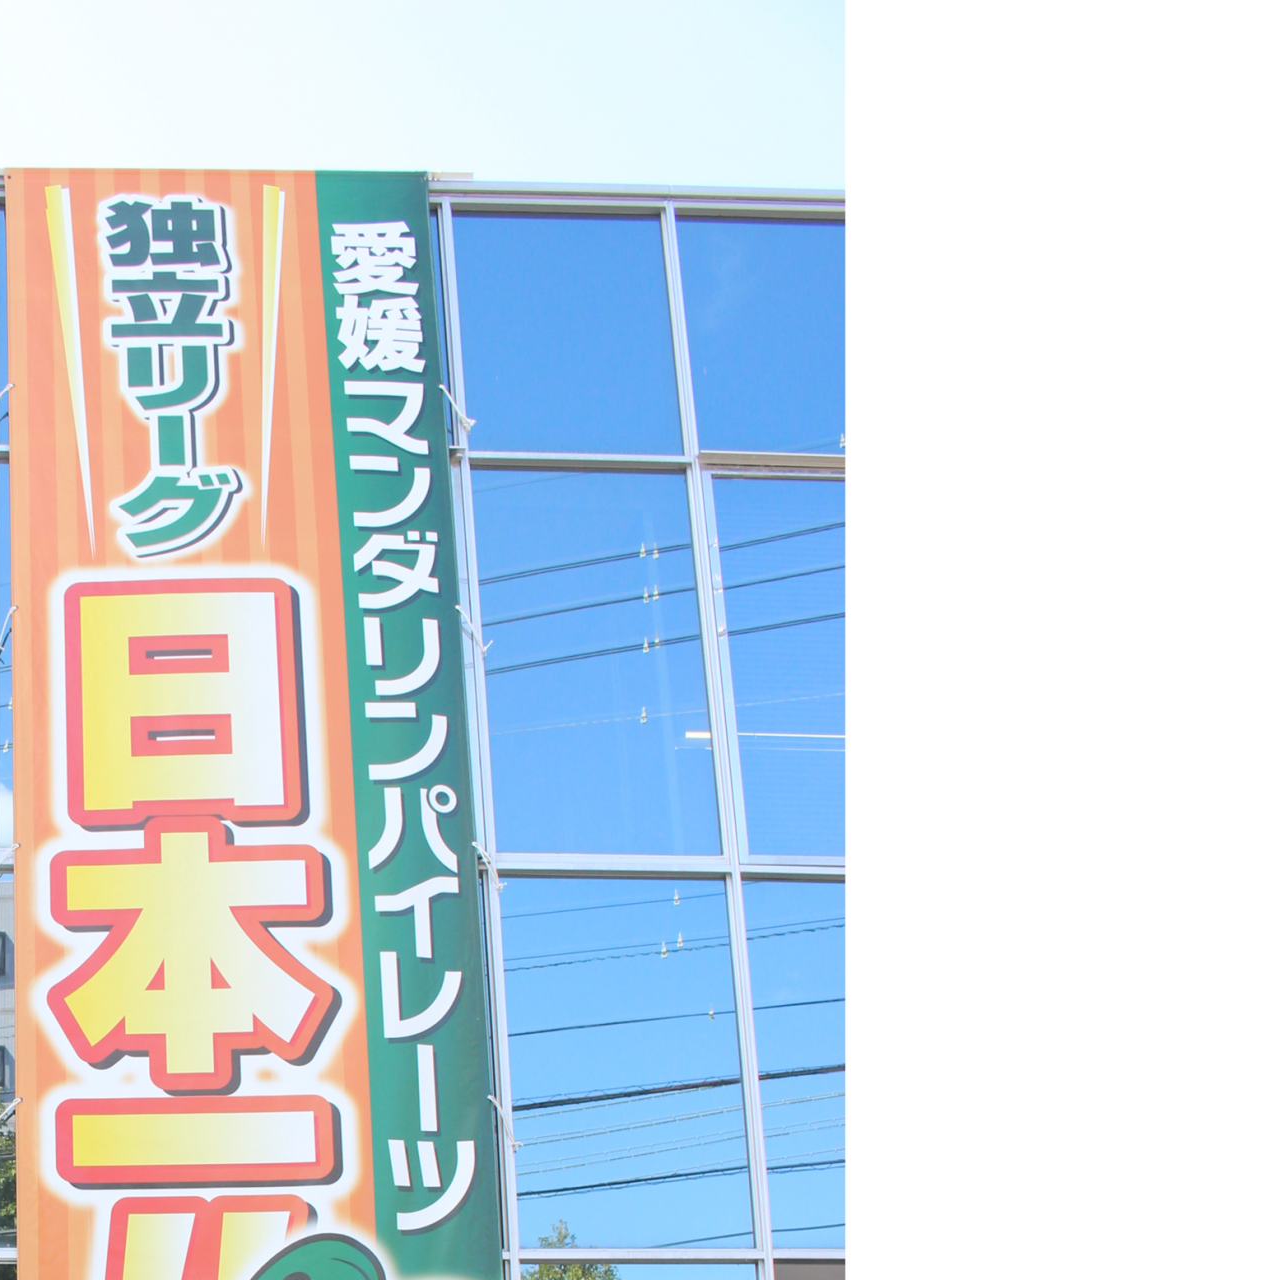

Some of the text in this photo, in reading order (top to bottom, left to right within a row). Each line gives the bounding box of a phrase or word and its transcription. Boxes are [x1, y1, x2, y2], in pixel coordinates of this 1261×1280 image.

[105, 199, 241, 556] 独立リーグ
[331, 221, 475, 1232] 愛媛マンダリンパイレーツ
